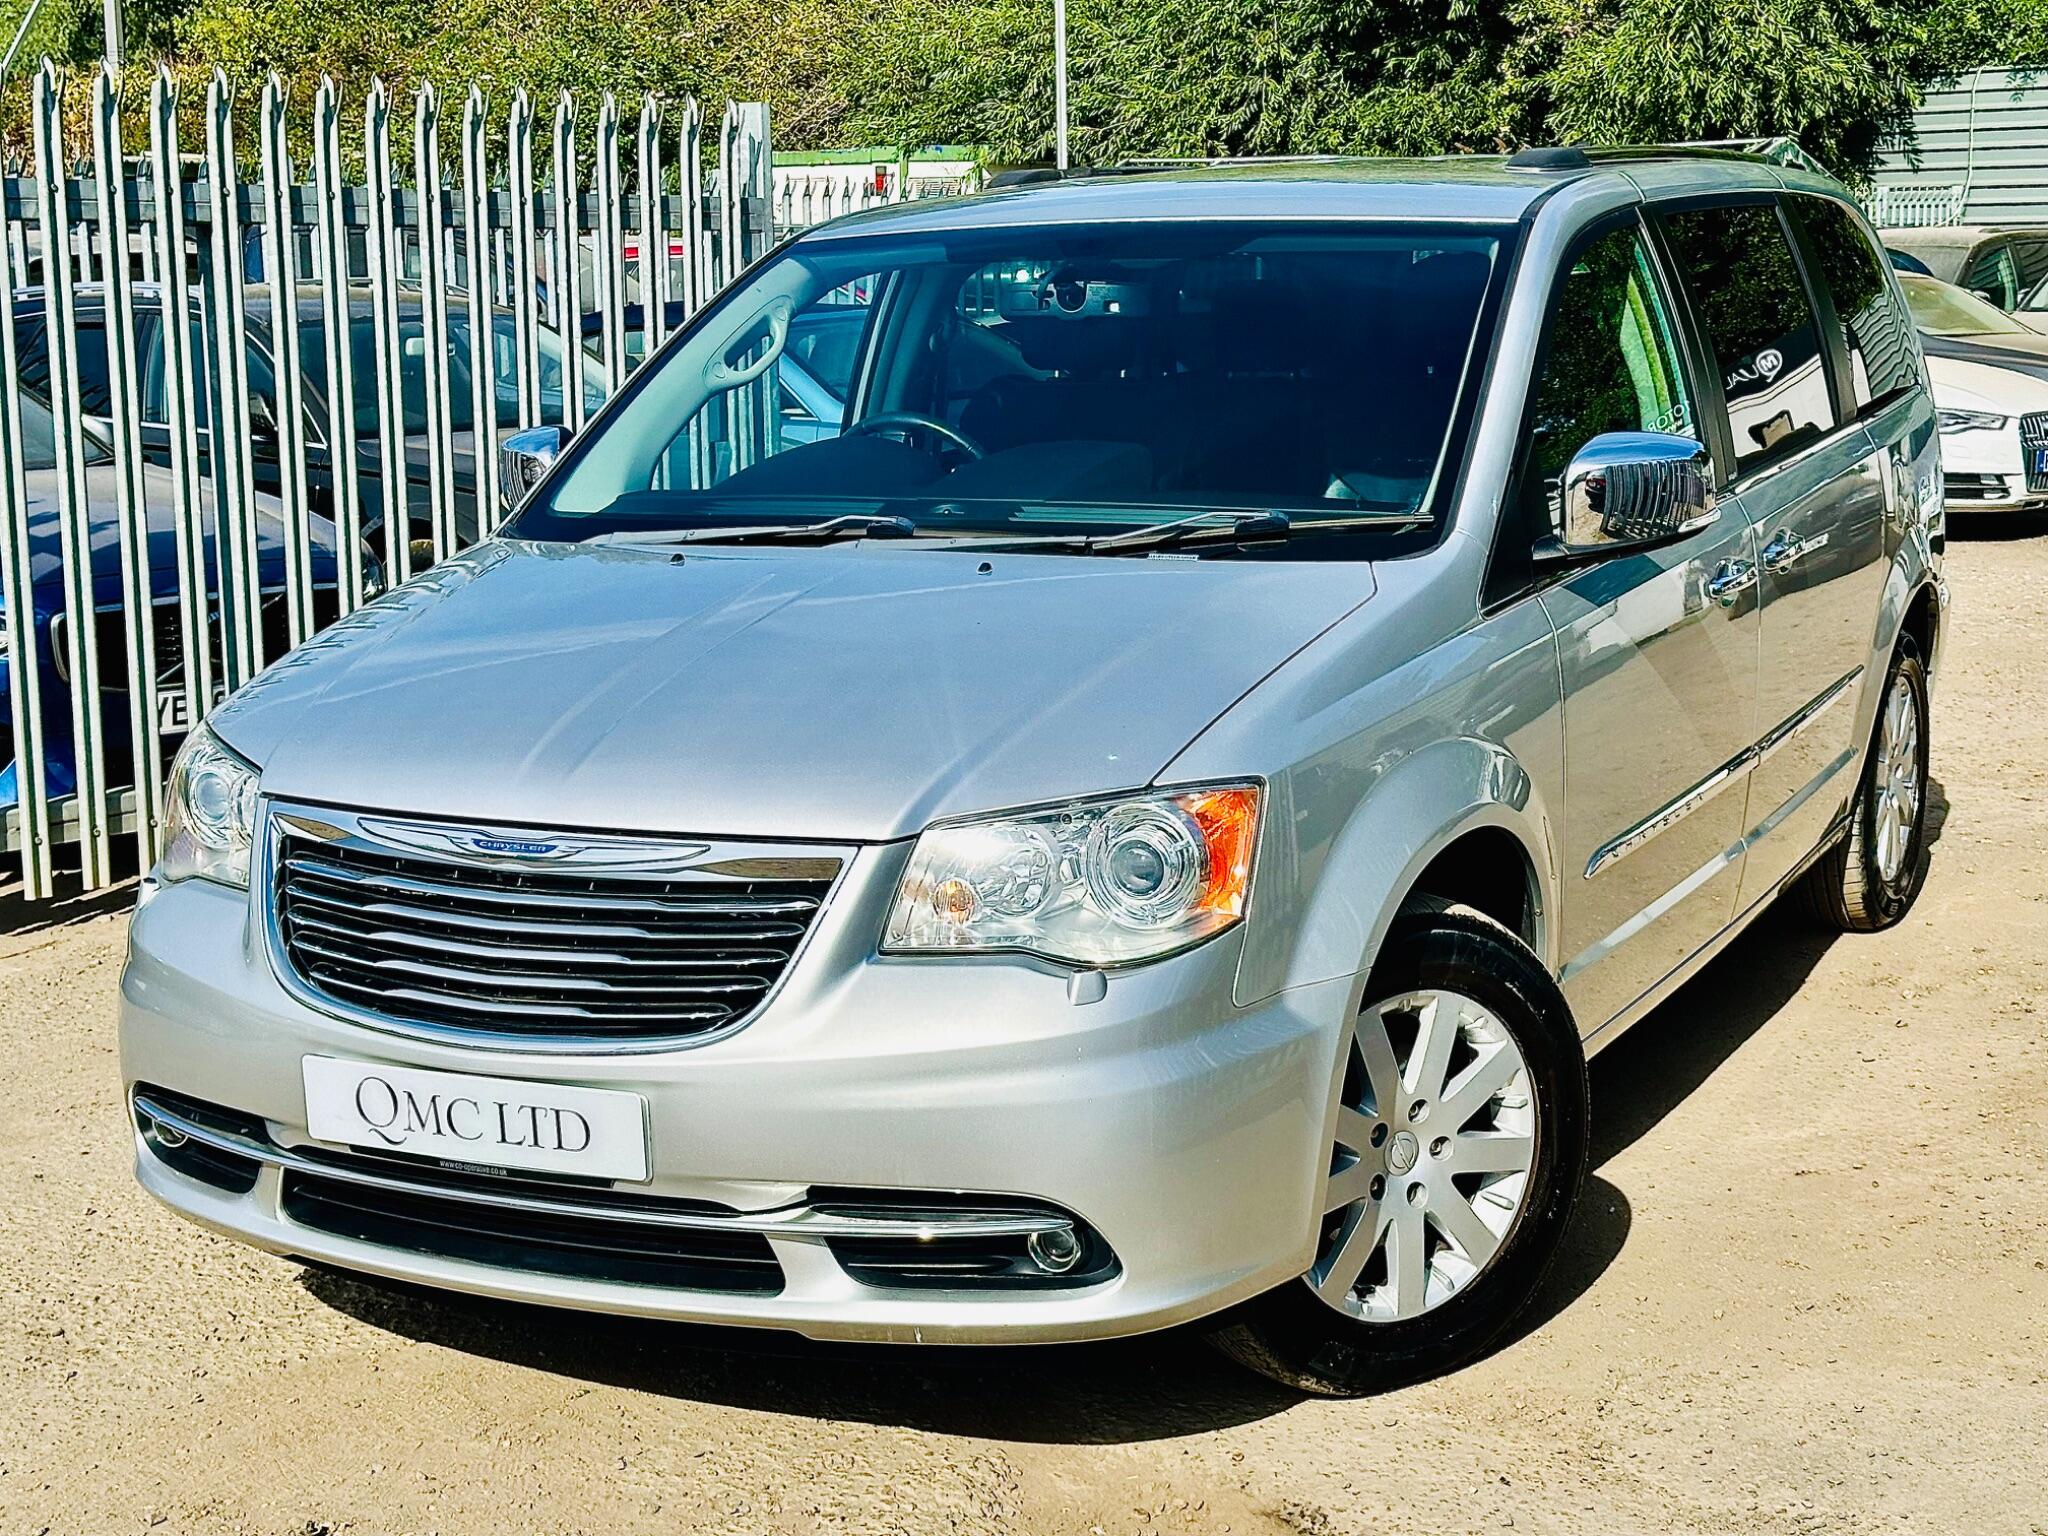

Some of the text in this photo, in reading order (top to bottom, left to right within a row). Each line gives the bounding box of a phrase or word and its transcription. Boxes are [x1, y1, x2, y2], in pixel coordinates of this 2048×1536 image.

[479, 841, 547, 852] CHRYSLER
[355, 1076, 591, 1152] QMC LTD
